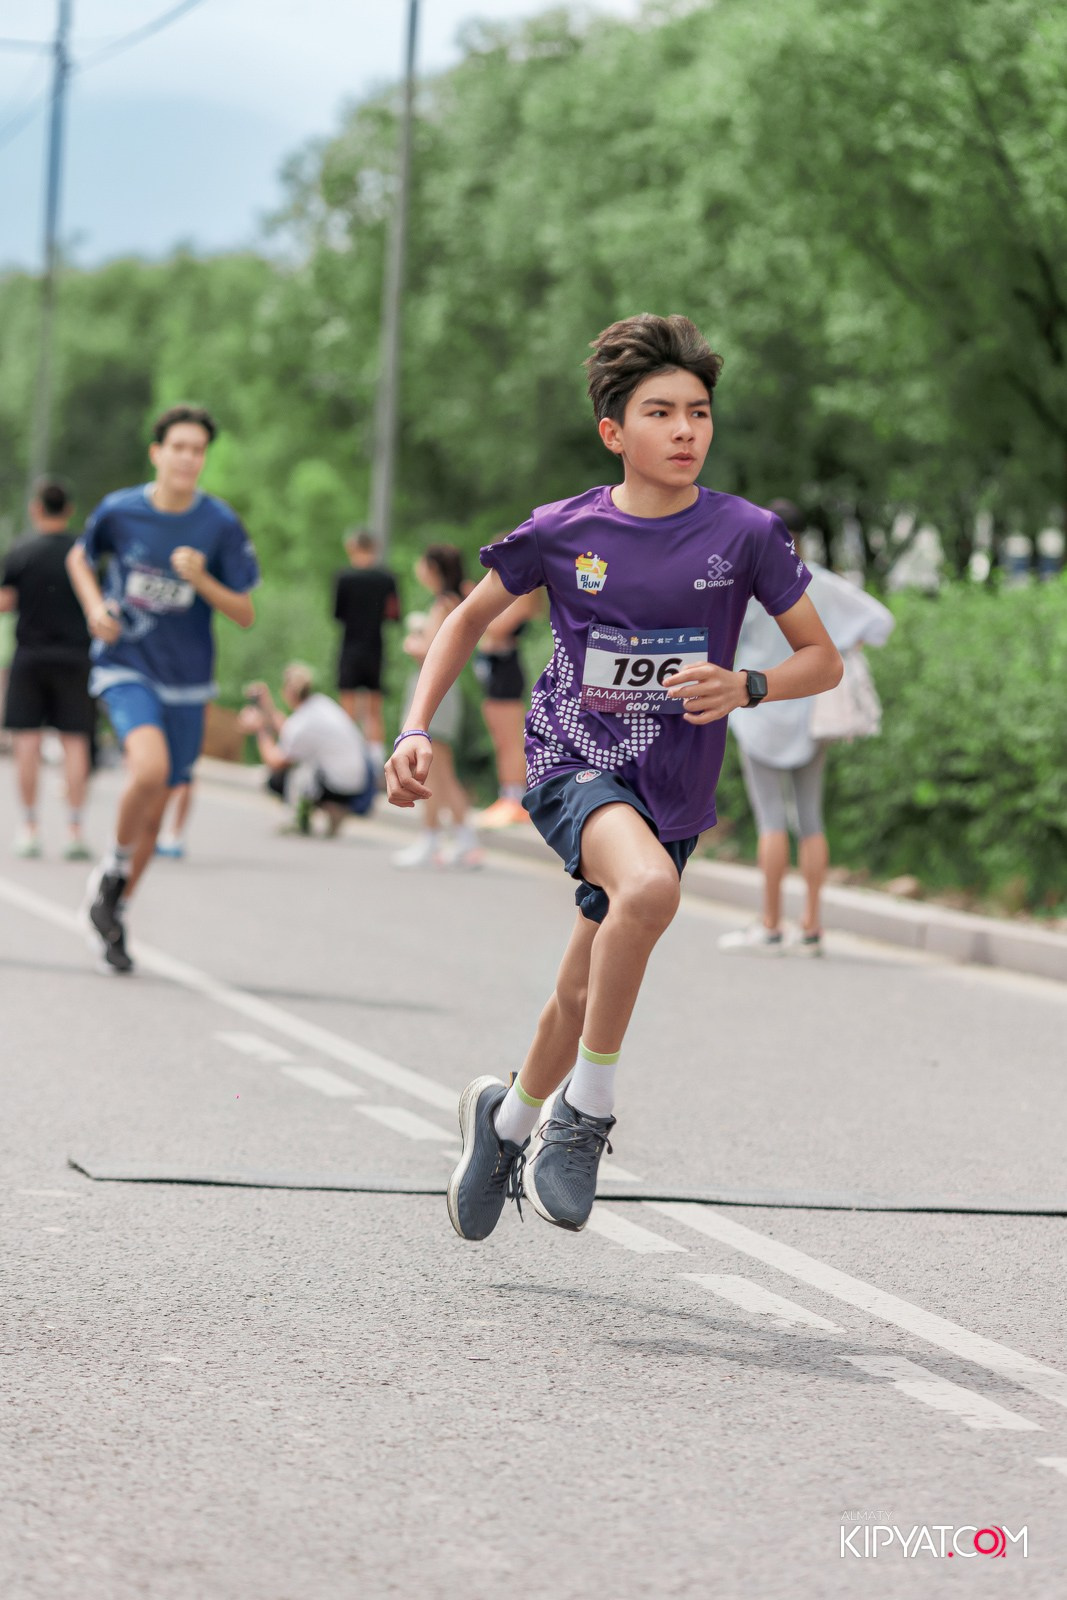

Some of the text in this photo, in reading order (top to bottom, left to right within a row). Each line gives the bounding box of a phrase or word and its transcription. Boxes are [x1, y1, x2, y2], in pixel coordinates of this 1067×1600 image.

[580, 574, 589, 582] BI
[582, 581, 601, 589] RUN
[707, 579, 735, 588] GROUP
[612, 658, 683, 687] 196
[586, 687, 643, 701] БАЛАЛАР
[626, 702, 650, 712] 600
